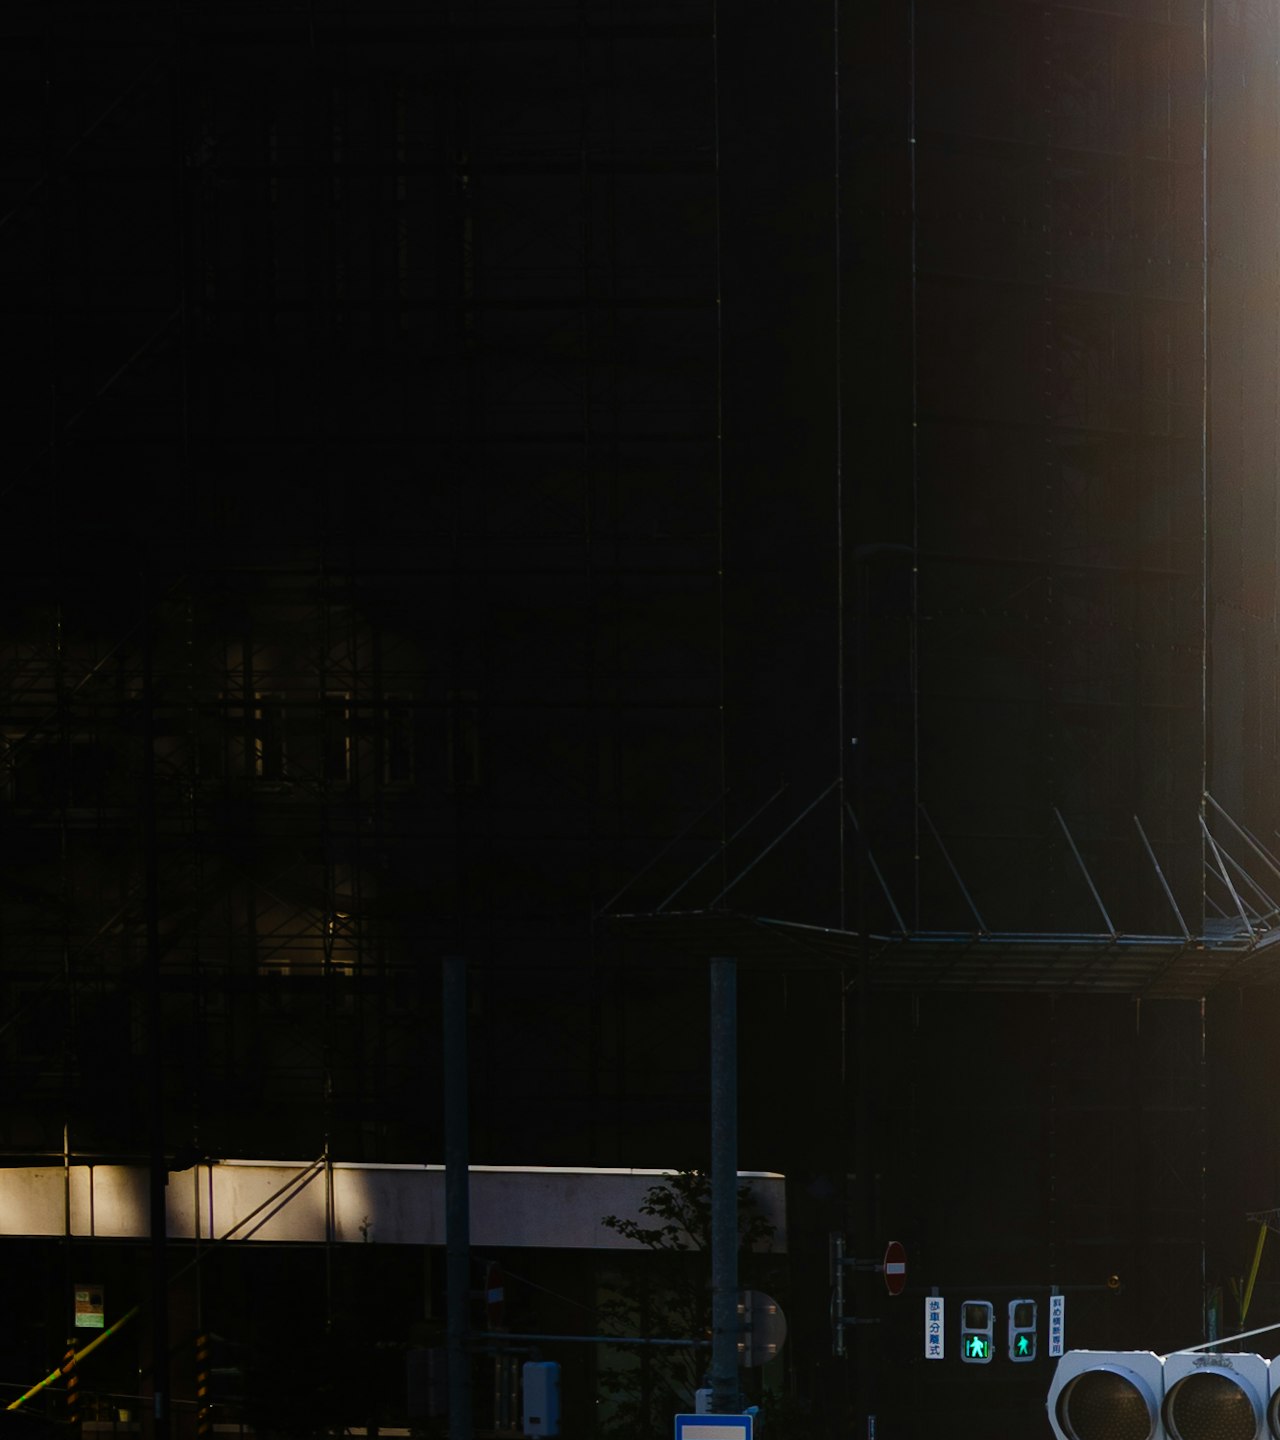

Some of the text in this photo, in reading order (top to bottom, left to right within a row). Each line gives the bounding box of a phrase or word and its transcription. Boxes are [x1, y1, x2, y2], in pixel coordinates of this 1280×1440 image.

[929, 1301, 940, 1355] 歩車分離式
